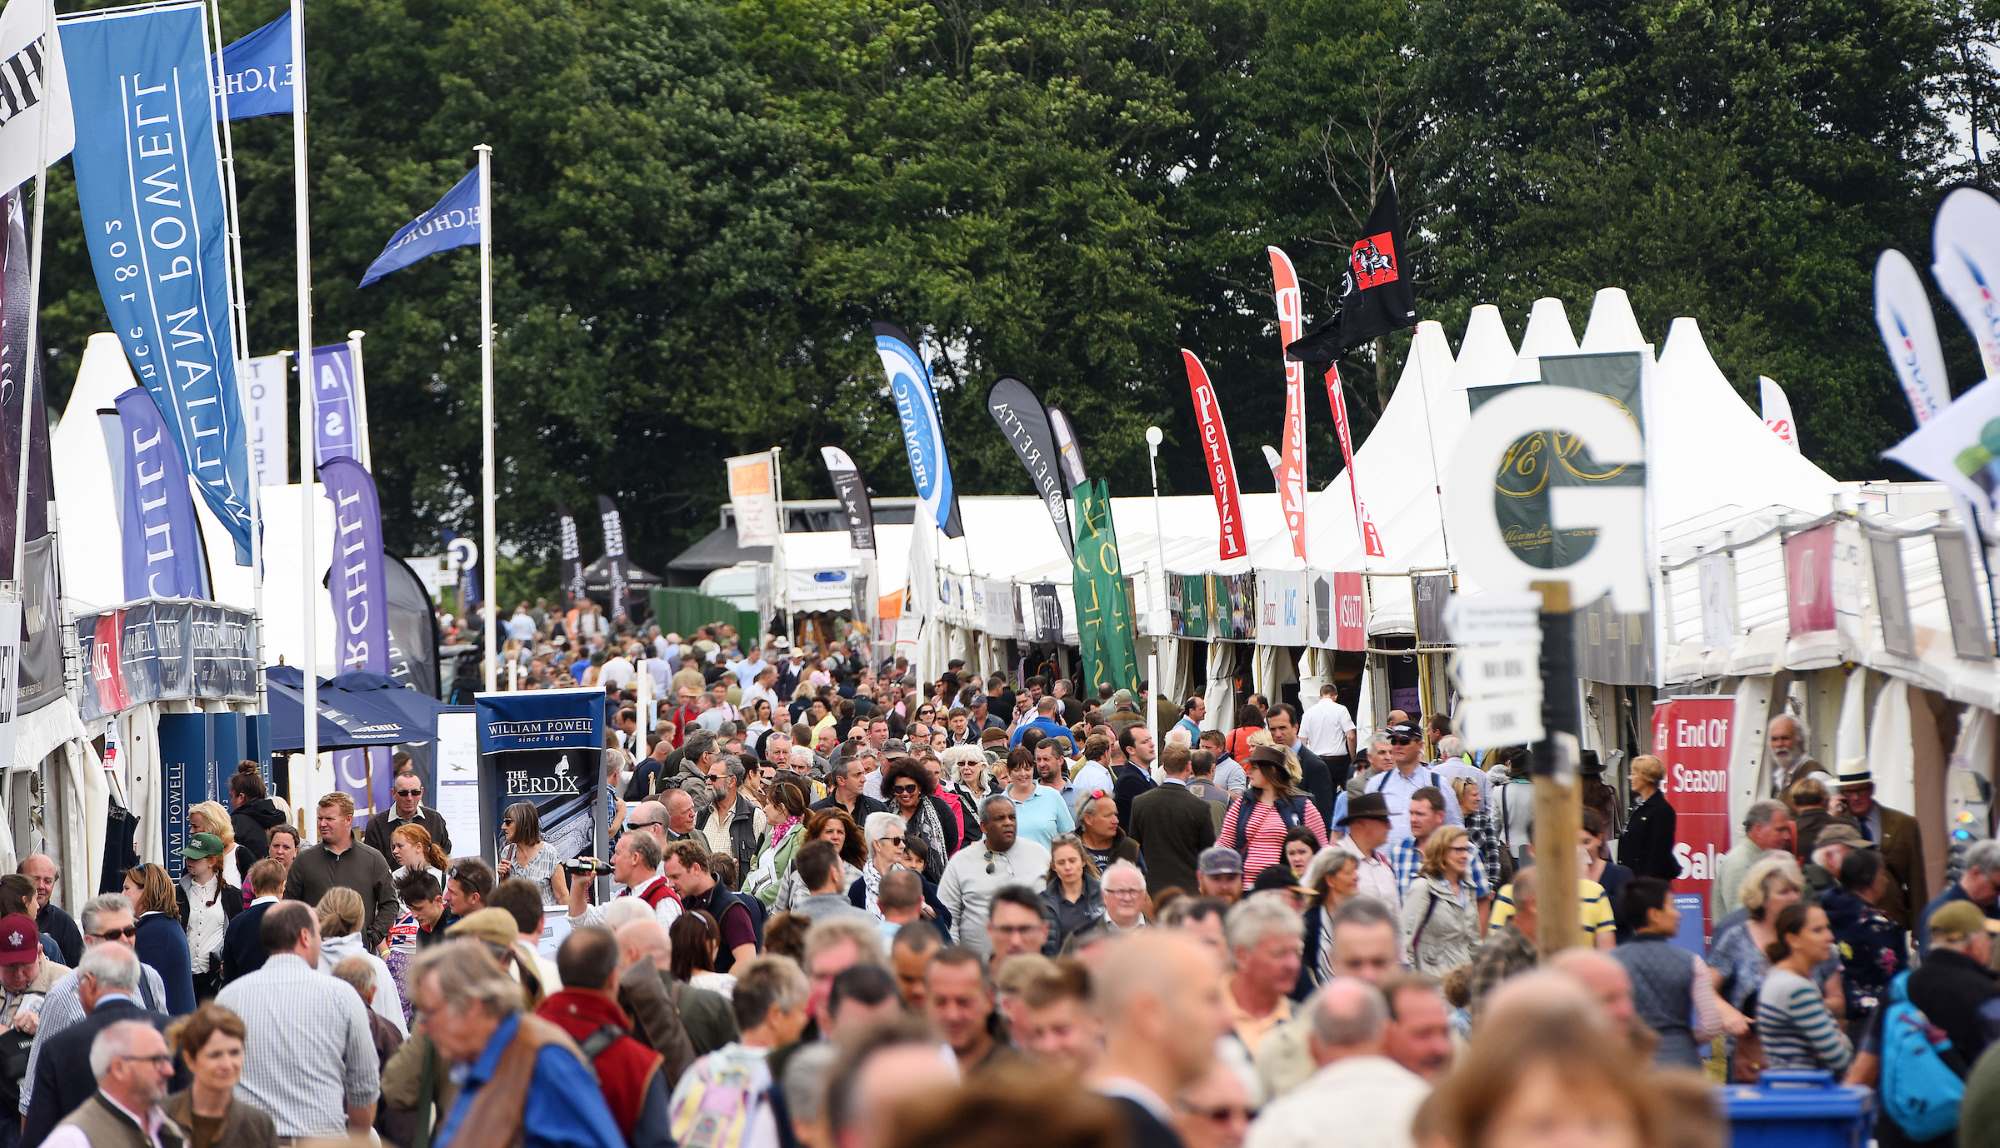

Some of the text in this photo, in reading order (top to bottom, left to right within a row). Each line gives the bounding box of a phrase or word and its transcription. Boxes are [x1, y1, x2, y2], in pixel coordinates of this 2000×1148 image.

[488, 720, 593, 736] WILLIAM POWELL
[1676, 718, 1728, 748] End Of
[506, 770, 527, 779] THE
[506, 776, 579, 795] PERDIX
[1673, 763, 1727, 793] Season
[170, 762, 182, 824] POWELL
